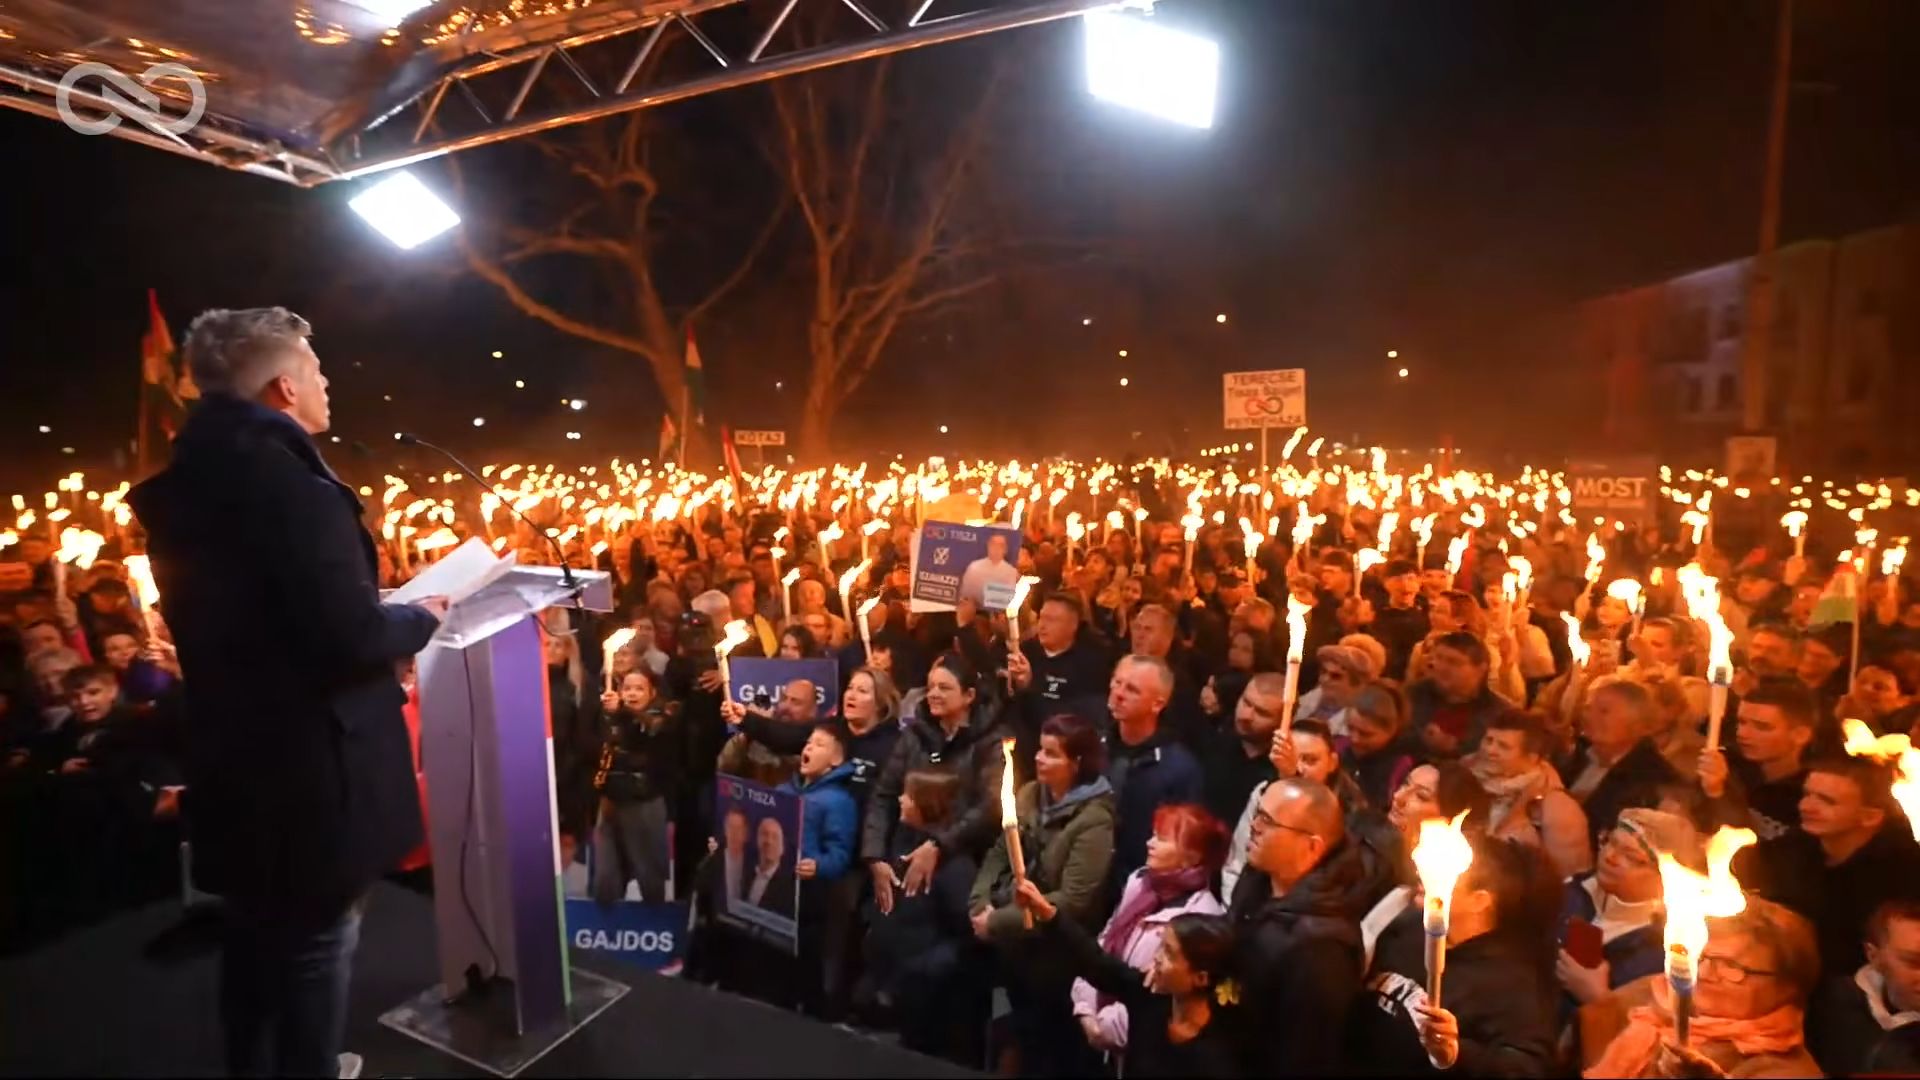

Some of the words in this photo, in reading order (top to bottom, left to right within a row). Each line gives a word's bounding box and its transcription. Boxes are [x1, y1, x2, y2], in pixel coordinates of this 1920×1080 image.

[1575, 477, 1647, 498] MOST
[739, 684, 826, 705] GAJS
[575, 928, 675, 953] GAJDOS
